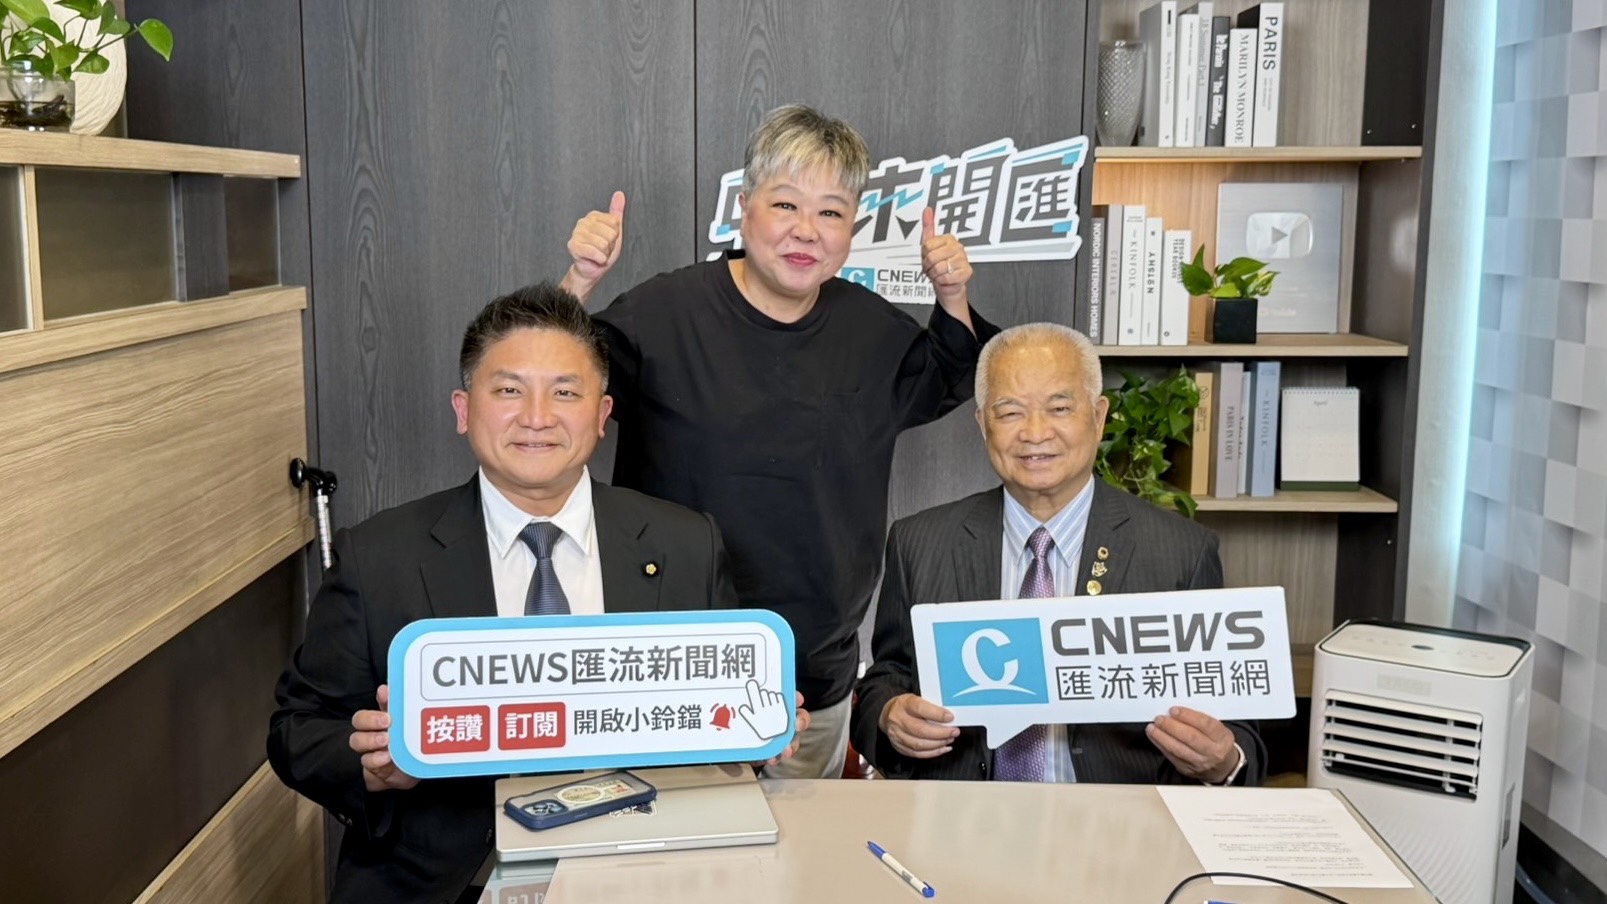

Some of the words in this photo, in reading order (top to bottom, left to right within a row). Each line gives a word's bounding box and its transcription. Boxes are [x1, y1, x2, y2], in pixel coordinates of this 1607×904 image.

[1237, 33, 1250, 90] MARILYN
[1262, 16, 1279, 71] PARIS
[1234, 91, 1246, 144] MONROE
[1092, 223, 1102, 257] NORDIC
[877, 269, 931, 283] CNEW
[1090, 258, 1100, 304] INTERIORS
[1128, 240, 1137, 290] KINFOLK
[1089, 305, 1099, 338] HOMES
[1226, 406, 1235, 429] PARIS
[1261, 400, 1271, 447] KINFOLK
[1224, 440, 1233, 462] LOVE
[1050, 610, 1266, 657] CNEWS
[1055, 659, 1272, 701] 匯流新聞網
[426, 714, 484, 745] 按讚
[503, 711, 559, 740] 訂閱
[573, 703, 702, 736] 開啟小鈴鐺
